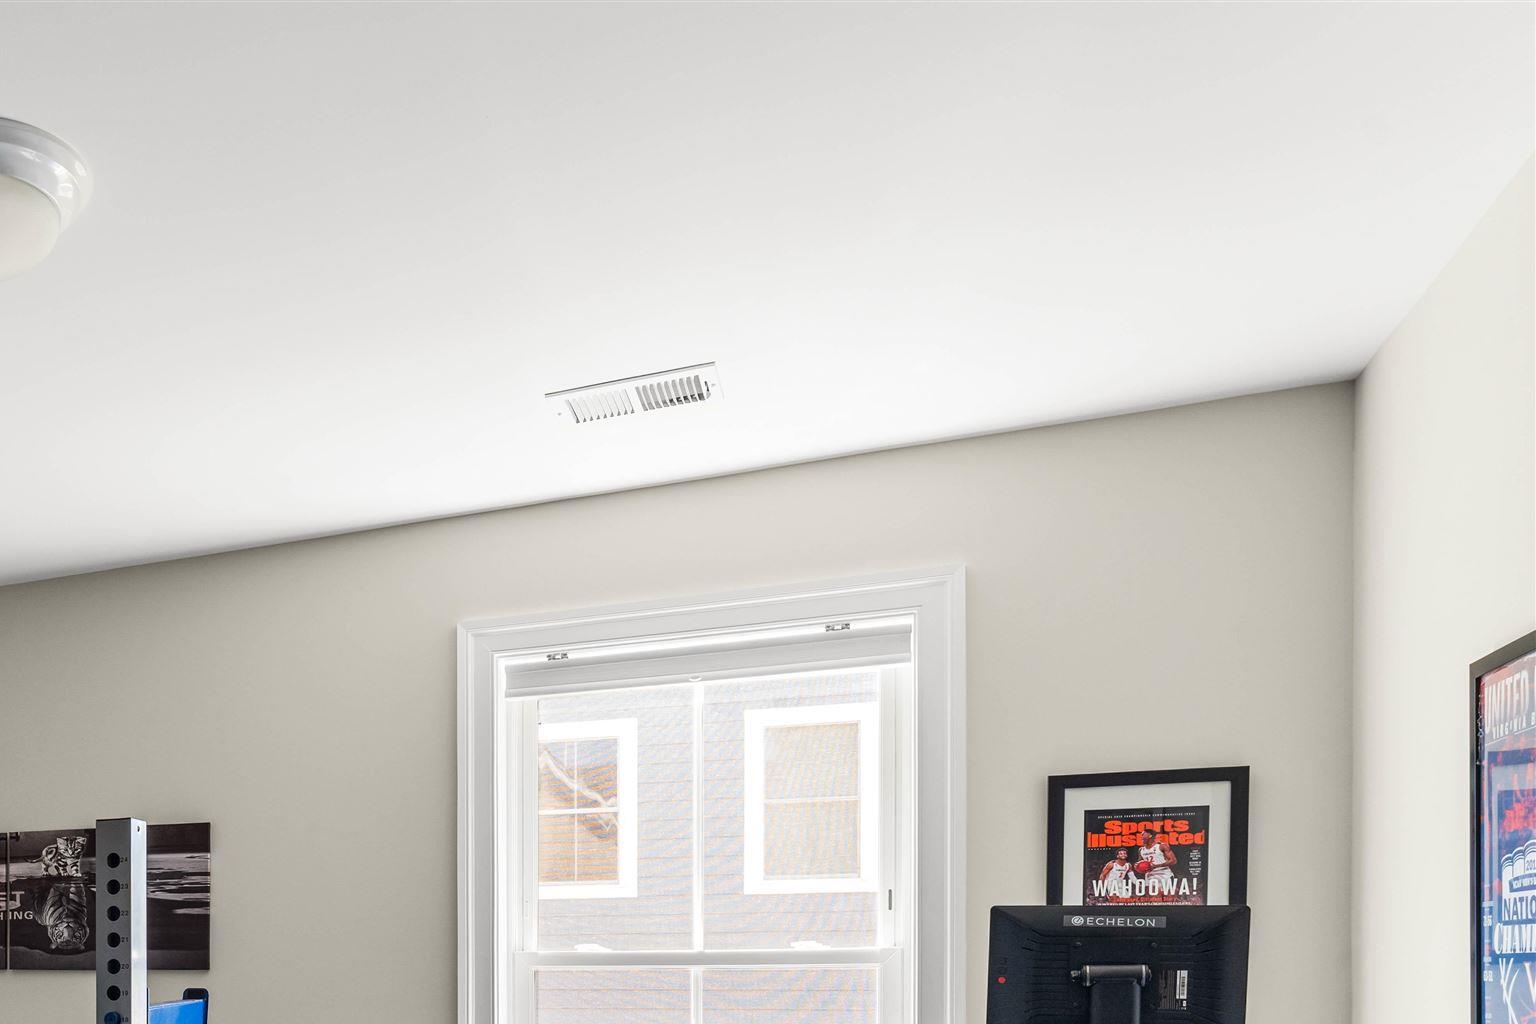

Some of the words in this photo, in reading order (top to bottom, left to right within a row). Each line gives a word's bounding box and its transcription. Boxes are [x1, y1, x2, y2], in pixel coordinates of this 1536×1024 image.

[1104, 819, 1190, 836] Sports
[1087, 829, 1206, 848] Illustated
[1092, 877, 1198, 898] WAHOOWA!
[1086, 917, 1156, 928] ECHELON
